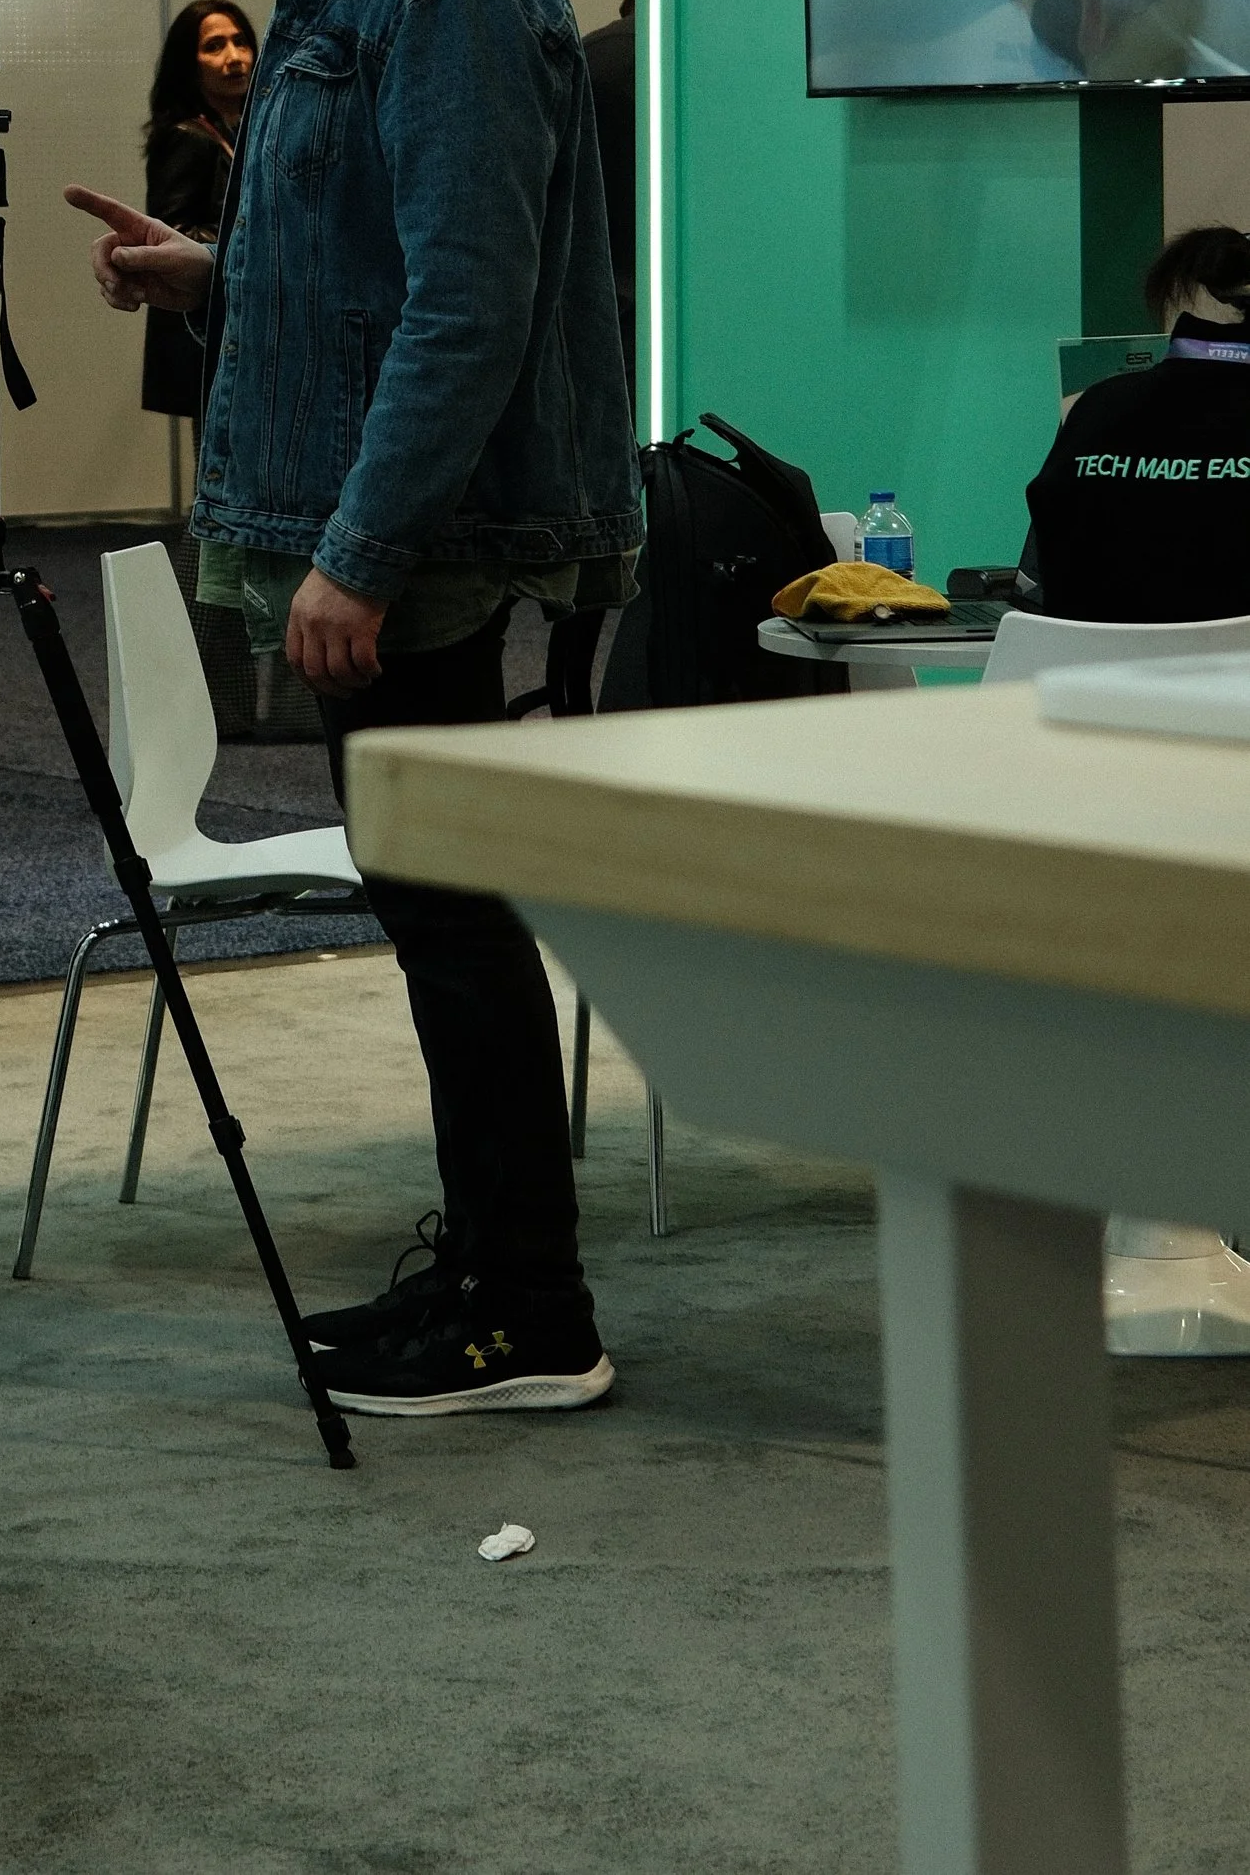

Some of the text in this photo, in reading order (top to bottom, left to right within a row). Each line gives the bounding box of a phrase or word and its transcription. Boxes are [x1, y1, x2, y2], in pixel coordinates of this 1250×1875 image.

[1125, 351, 1153, 366] ESR
[1207, 348, 1249, 360] AFEELA
[1075, 454, 1131, 478] TECH
[1135, 456, 1202, 481] MADE
